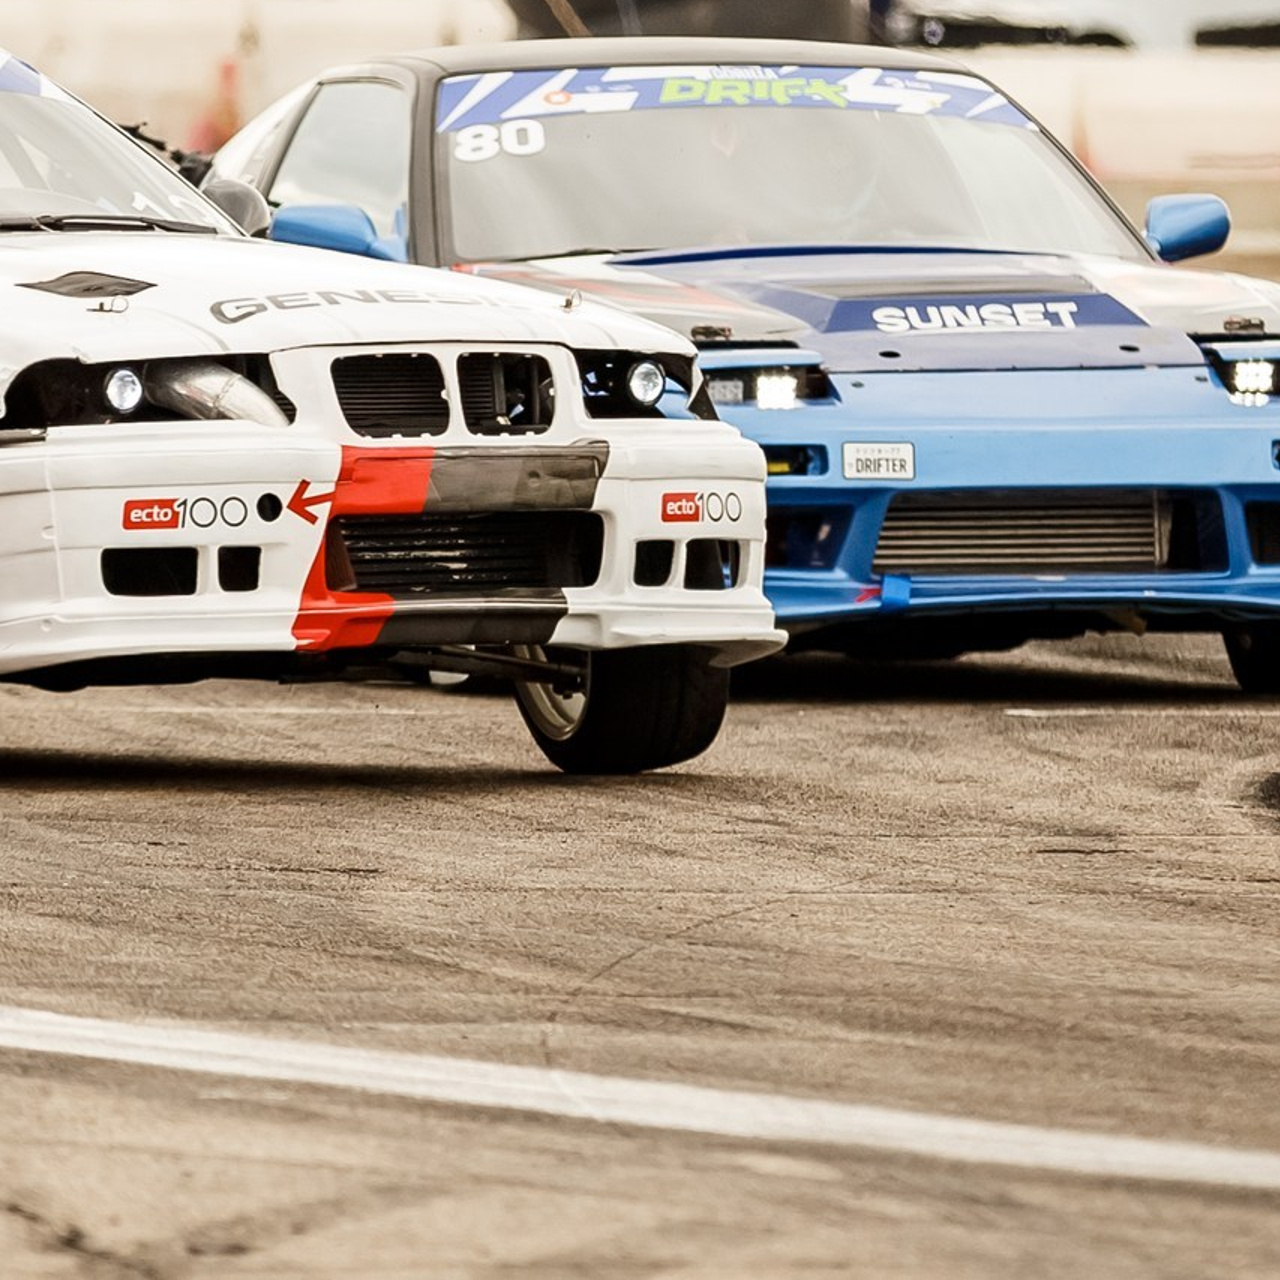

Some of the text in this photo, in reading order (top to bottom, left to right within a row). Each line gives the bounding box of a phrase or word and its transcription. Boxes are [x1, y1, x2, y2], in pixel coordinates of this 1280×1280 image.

[659, 77, 849, 108] DRIFT
[453, 119, 546, 162] 80
[872, 301, 1079, 334] SUNSET
[855, 457, 907, 473] DRIFTER
